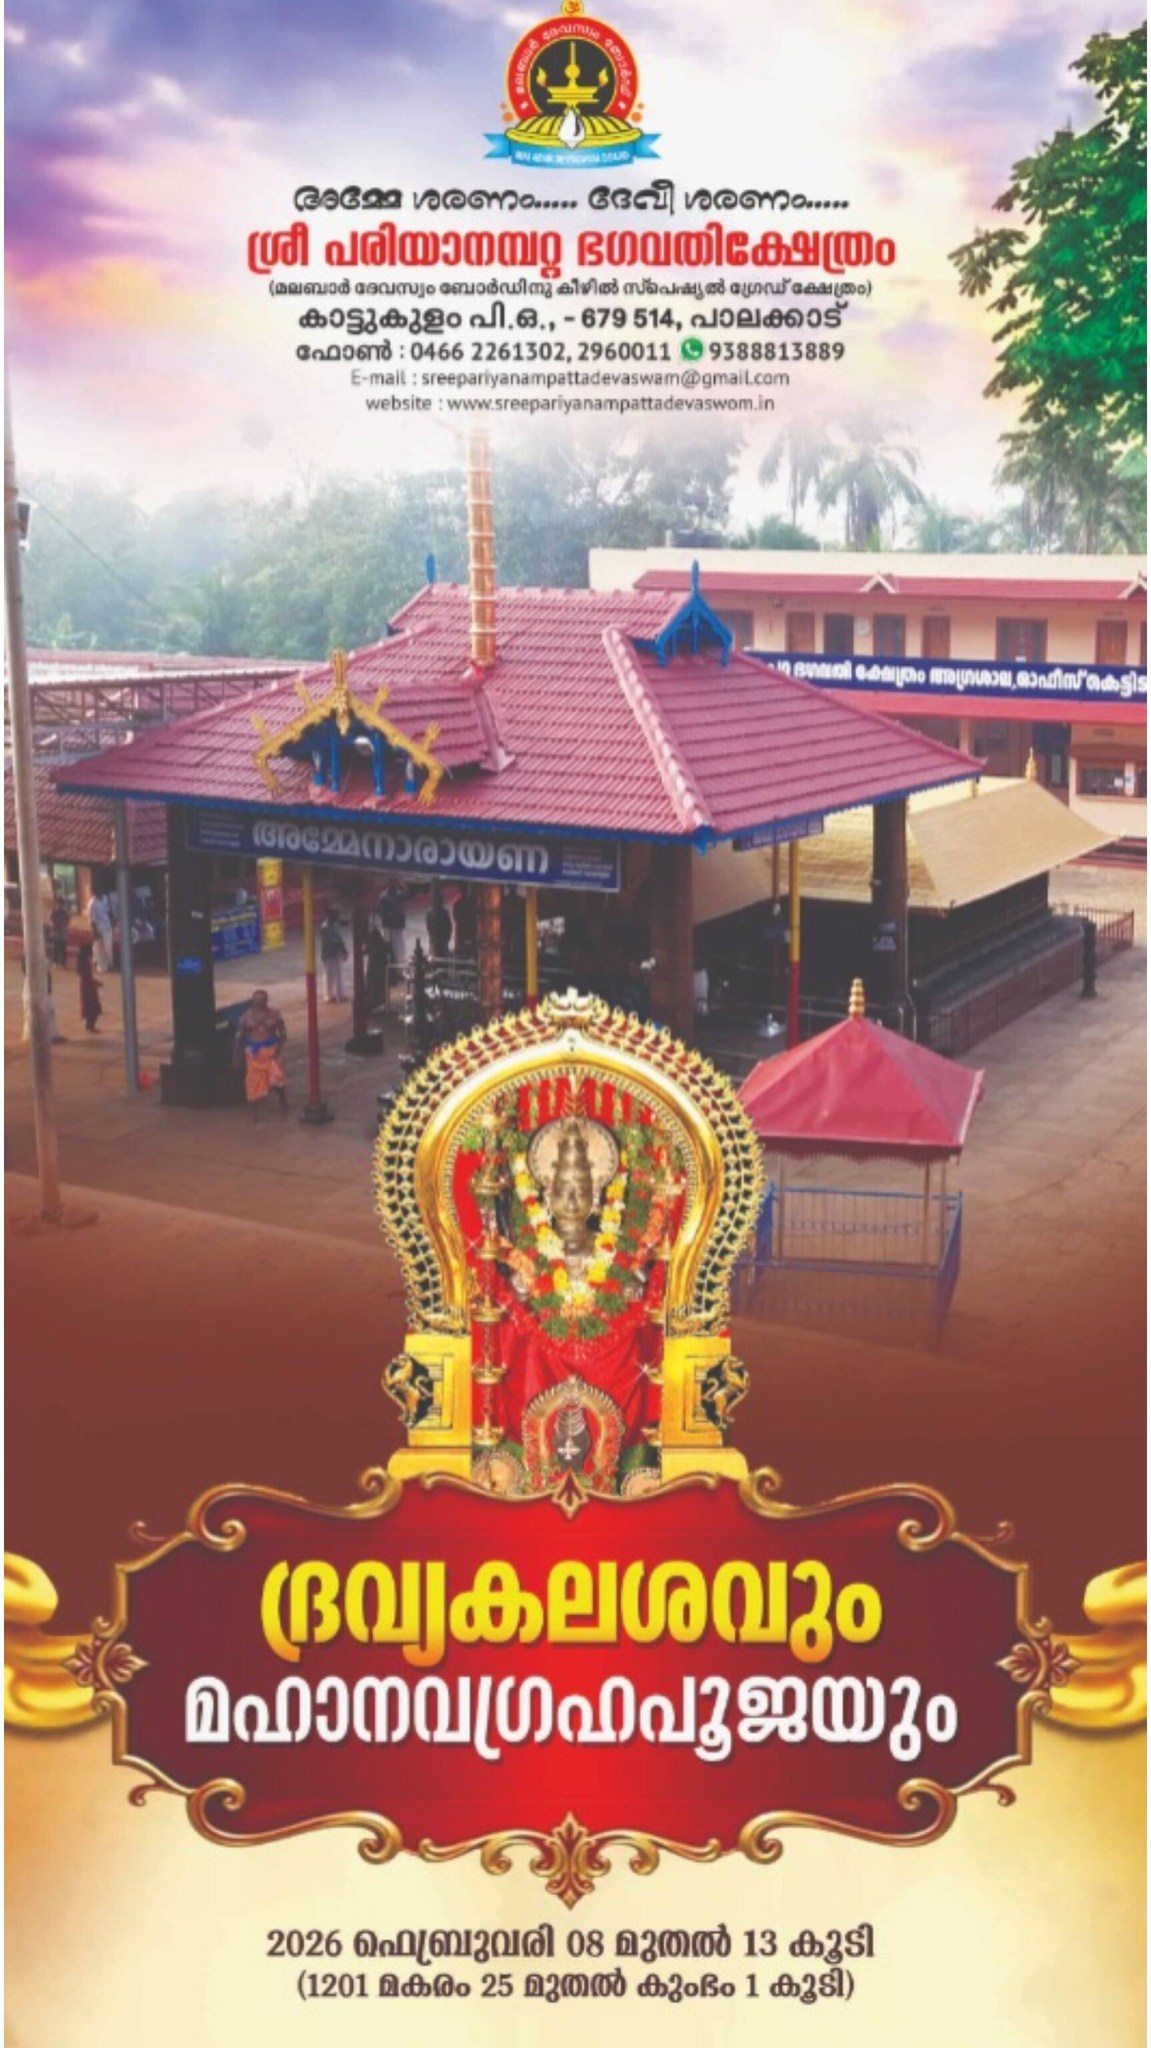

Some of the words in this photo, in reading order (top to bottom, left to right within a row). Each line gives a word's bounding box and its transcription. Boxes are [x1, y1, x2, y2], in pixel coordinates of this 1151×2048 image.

[293, 184, 402, 212] അമ്മേ
[587, 179, 675, 215] ദേവീ
[247, 220, 310, 276] ശ്രീ
[324, 221, 563, 280] പരിയാനമ്പറ്റ
[576, 220, 897, 275] ഭഗവതിക്ഷേത്രം
[268, 278, 351, 297] (മലബാർ
[354, 281, 436, 299] ദേവസ്വം
[439, 278, 553, 299] ബോർഡിനു
[556, 278, 620, 296] കീഴിൽ
[622, 278, 727, 300] സ്പെഷ്യൽ
[729, 278, 789, 299] ഗ്രേഡ്
[790, 280, 872, 299] ക്ഷേത്രം)
[298, 307, 463, 336] കാട്ടുകുളം
[581, 307, 628, 329] 679
[633, 307, 683, 332] 514,
[690, 299, 850, 329] പാലക്കാട്
[296, 338, 393, 361] ഫോൺ
[410, 342, 464, 361] 0466
[471, 342, 572, 364] 2261302,
[577, 342, 671, 362] 2960011
[708, 341, 845, 362] 9388813889
[350, 369, 406, 386] E-mail
[365, 394, 432, 411] website
[447, 394, 775, 415] www.sreepariyanampattadevaswom.in
[793, 659, 853, 680] ഭഗവതി
[855, 663, 926, 688] ക്ഷേത്രം
[252, 818, 549, 875] അമ്മേനാരായണ
[260, 1559, 883, 1663] ദ്രവ്യകലശവും
[184, 1675, 959, 1762] മഹാനവഗ്രഹപൂജയും
[267, 1929, 343, 1958] 2026
[353, 1922, 555, 1964] ഫെബ്രുവരി
[566, 1929, 605, 1958] 08
[615, 1922, 732, 1964] മുതൽ
[744, 1929, 778, 1957] 13
[788, 1922, 875, 1964] കൂടി
[297, 1970, 369, 2001] (1201
[378, 1971, 471, 1998] മകരം
[481, 1973, 514, 1998] 25
[523, 1967, 627, 2003] മുതൽ
[637, 1973, 736, 2003] കുംഭം
[746, 1973, 759, 1997] 1
[769, 1967, 856, 2005] കൂടി)
